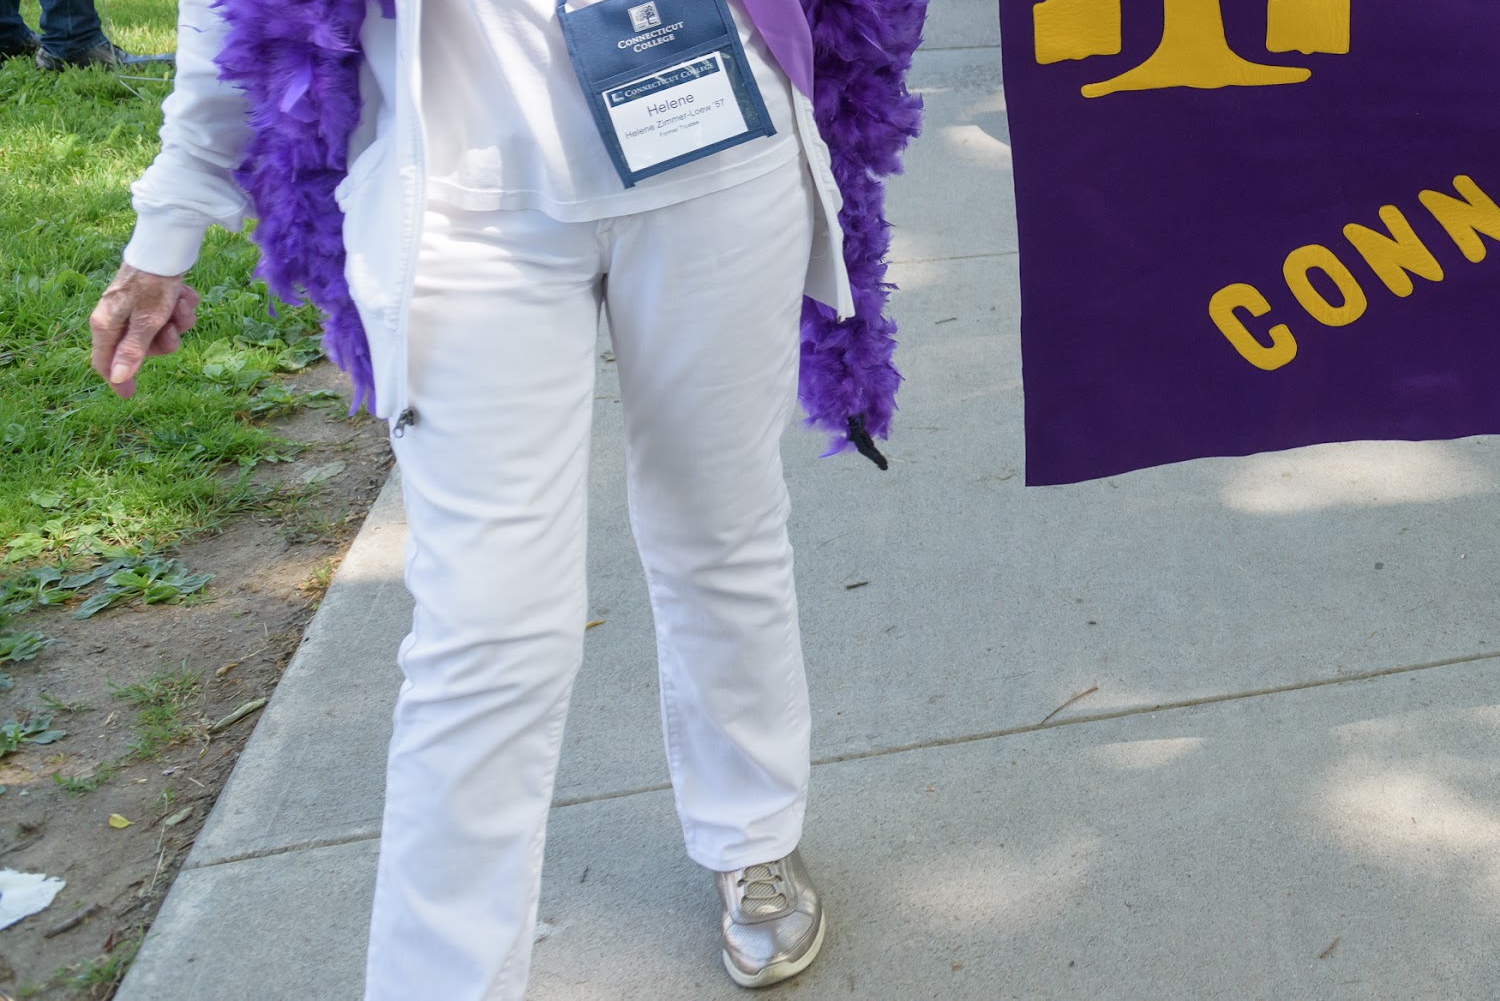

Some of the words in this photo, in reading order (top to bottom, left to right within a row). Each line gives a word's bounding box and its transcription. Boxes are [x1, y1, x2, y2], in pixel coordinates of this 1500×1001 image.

[617, 21, 684, 49] CONNECTICUT
[633, 34, 675, 53] COLLEGE
[646, 94, 695, 117] Helene
[625, 125, 655, 139] Helene
